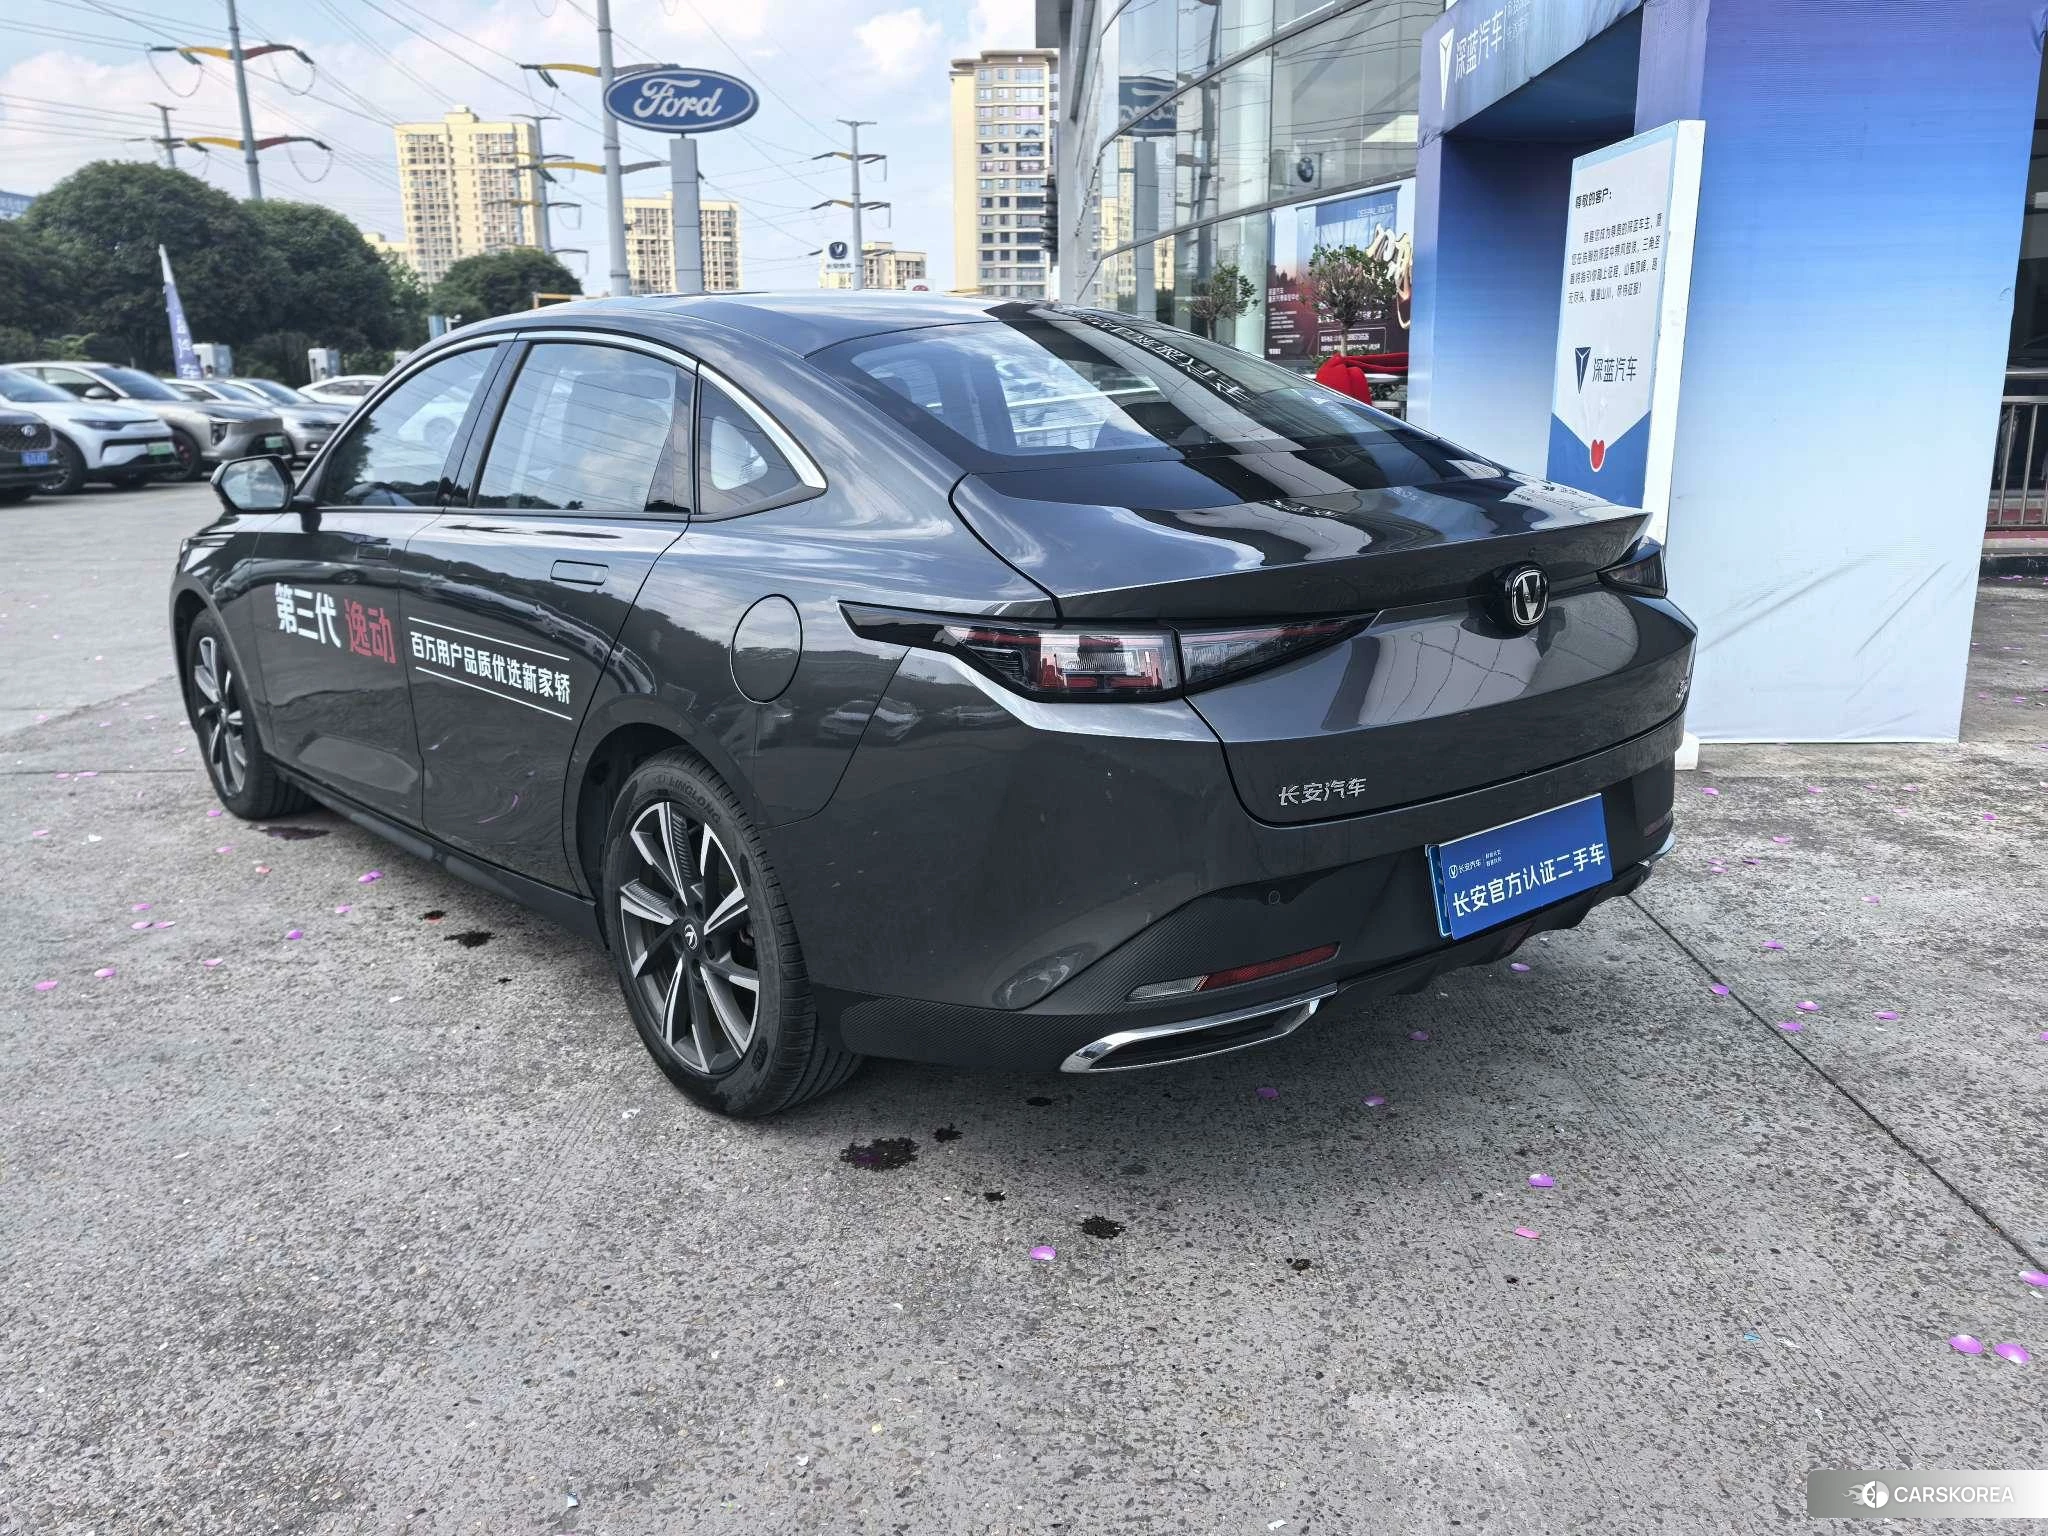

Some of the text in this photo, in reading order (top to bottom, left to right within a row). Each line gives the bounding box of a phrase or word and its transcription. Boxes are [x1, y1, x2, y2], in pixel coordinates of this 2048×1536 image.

[1455, 9, 1504, 83] 深蓝汽车
[633, 78, 723, 117] Ford
[1592, 355, 1639, 383] 深蓝汽车
[274, 582, 397, 665] 第三代 逸动
[410, 630, 571, 705] 百万用户品质优选新家轿
[1278, 776, 1367, 807] 长安汽车
[1452, 842, 1607, 918] 长安官方认证二手车
